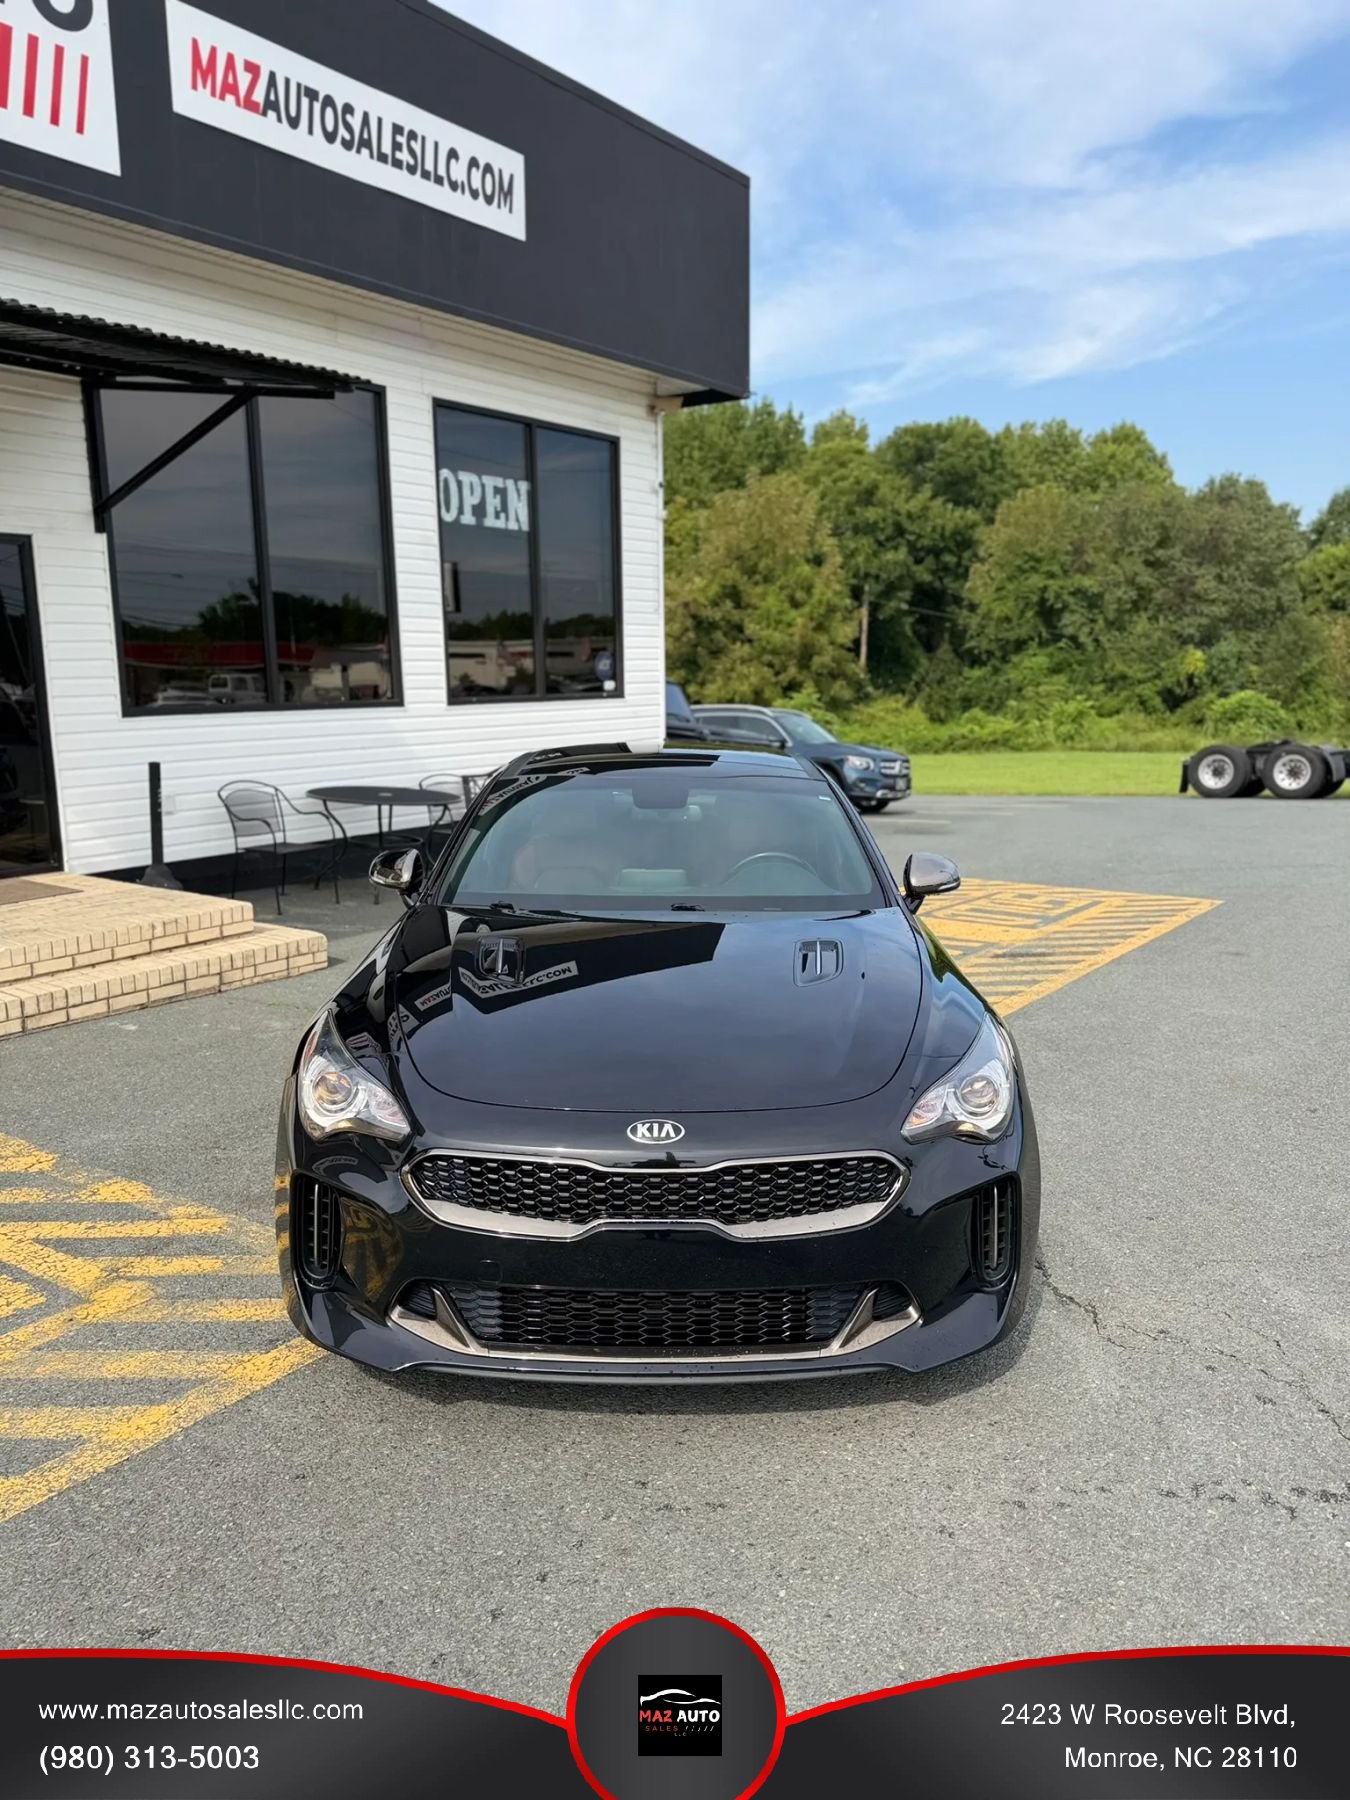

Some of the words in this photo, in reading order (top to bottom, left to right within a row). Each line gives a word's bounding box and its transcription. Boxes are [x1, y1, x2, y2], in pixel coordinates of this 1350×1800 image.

[191, 37, 514, 214] MAZAUTOSALESLLC.COM
[438, 468, 530, 532] OPEN
[637, 1123, 676, 1138] KIA
